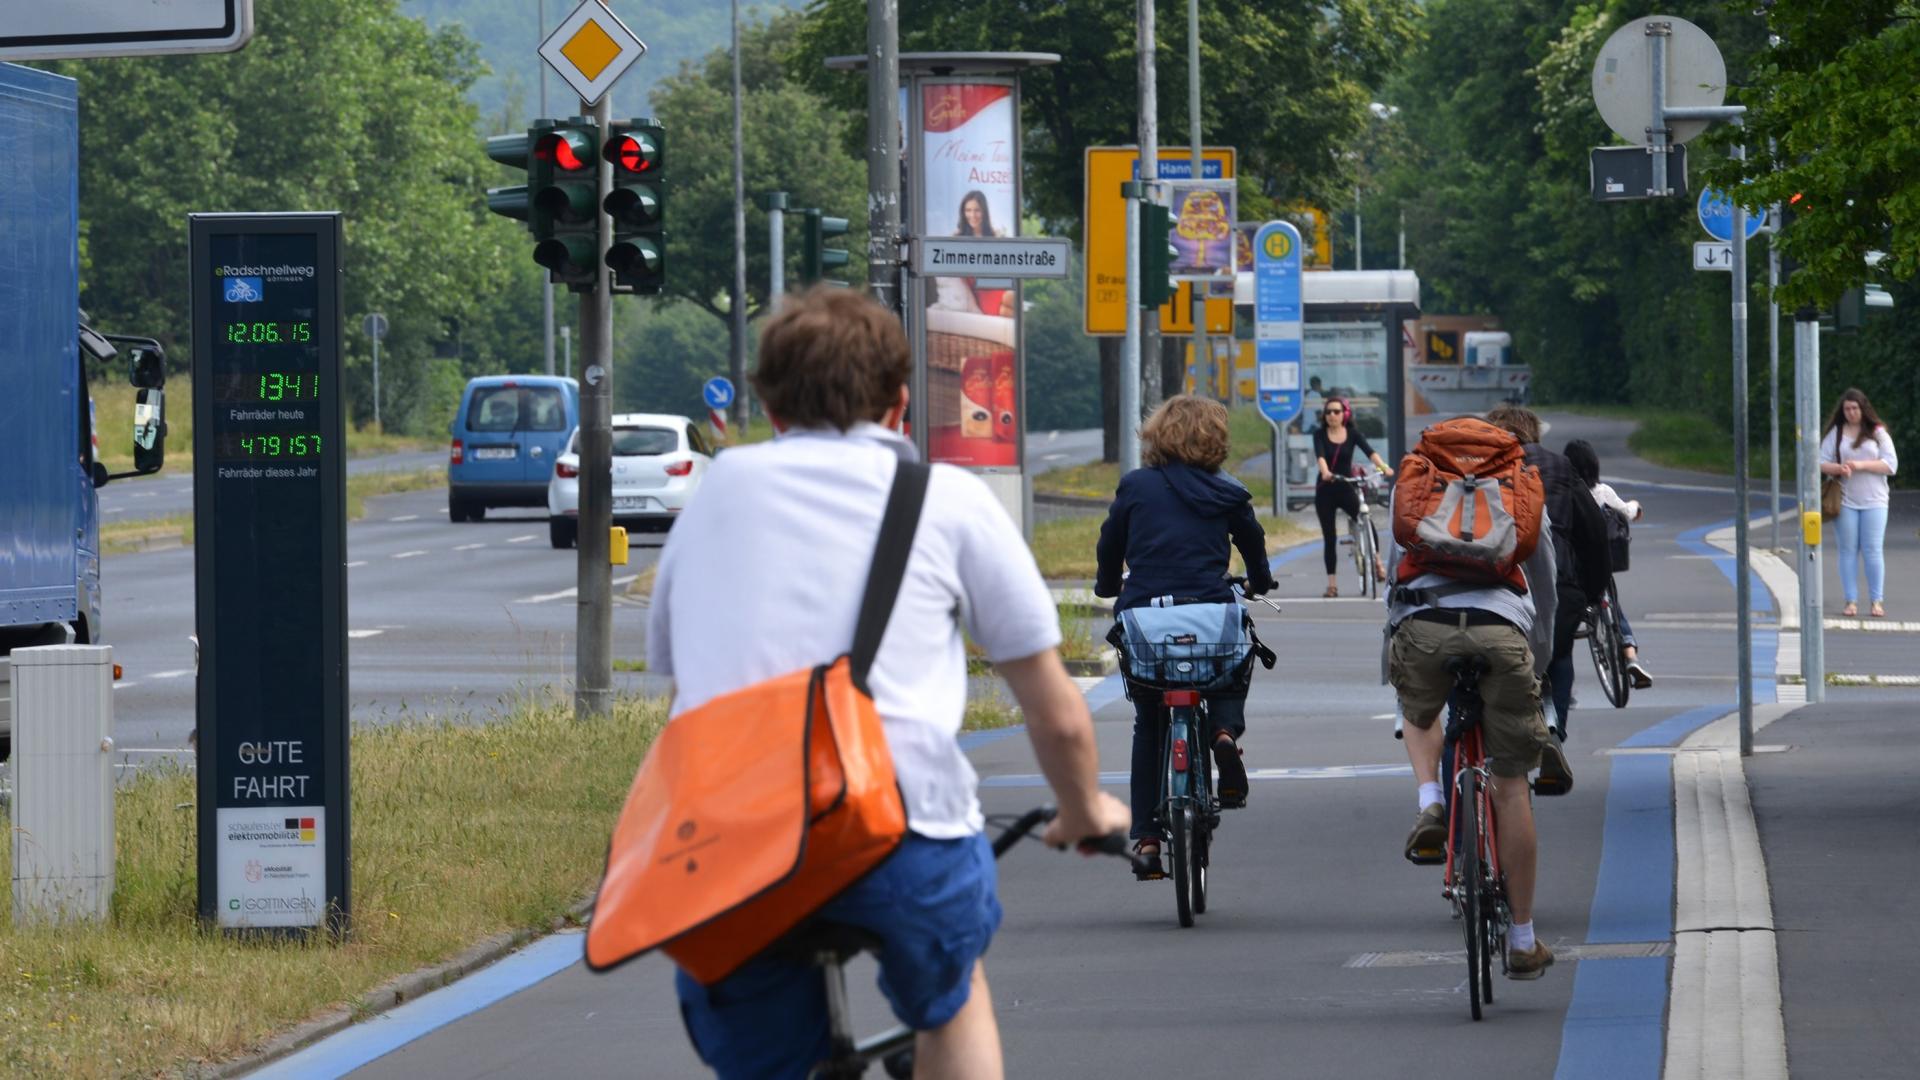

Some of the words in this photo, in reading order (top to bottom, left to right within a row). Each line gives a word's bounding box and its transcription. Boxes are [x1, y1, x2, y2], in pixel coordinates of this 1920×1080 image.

[933, 248, 1056, 266] Zimmermannstraße
[215, 265, 315, 277] eRadschnellweg
[260, 373, 319, 401] 1341
[230, 409, 276, 421] Fahrräder
[278, 409, 304, 420] heute
[218, 467, 264, 479] Fahrräder
[265, 466, 295, 478] dieses
[297, 466, 318, 478] Jahr
[238, 741, 304, 765] GUTE
[234, 775, 310, 799] FAHRT
[228, 831, 300, 841] elektromobilität
